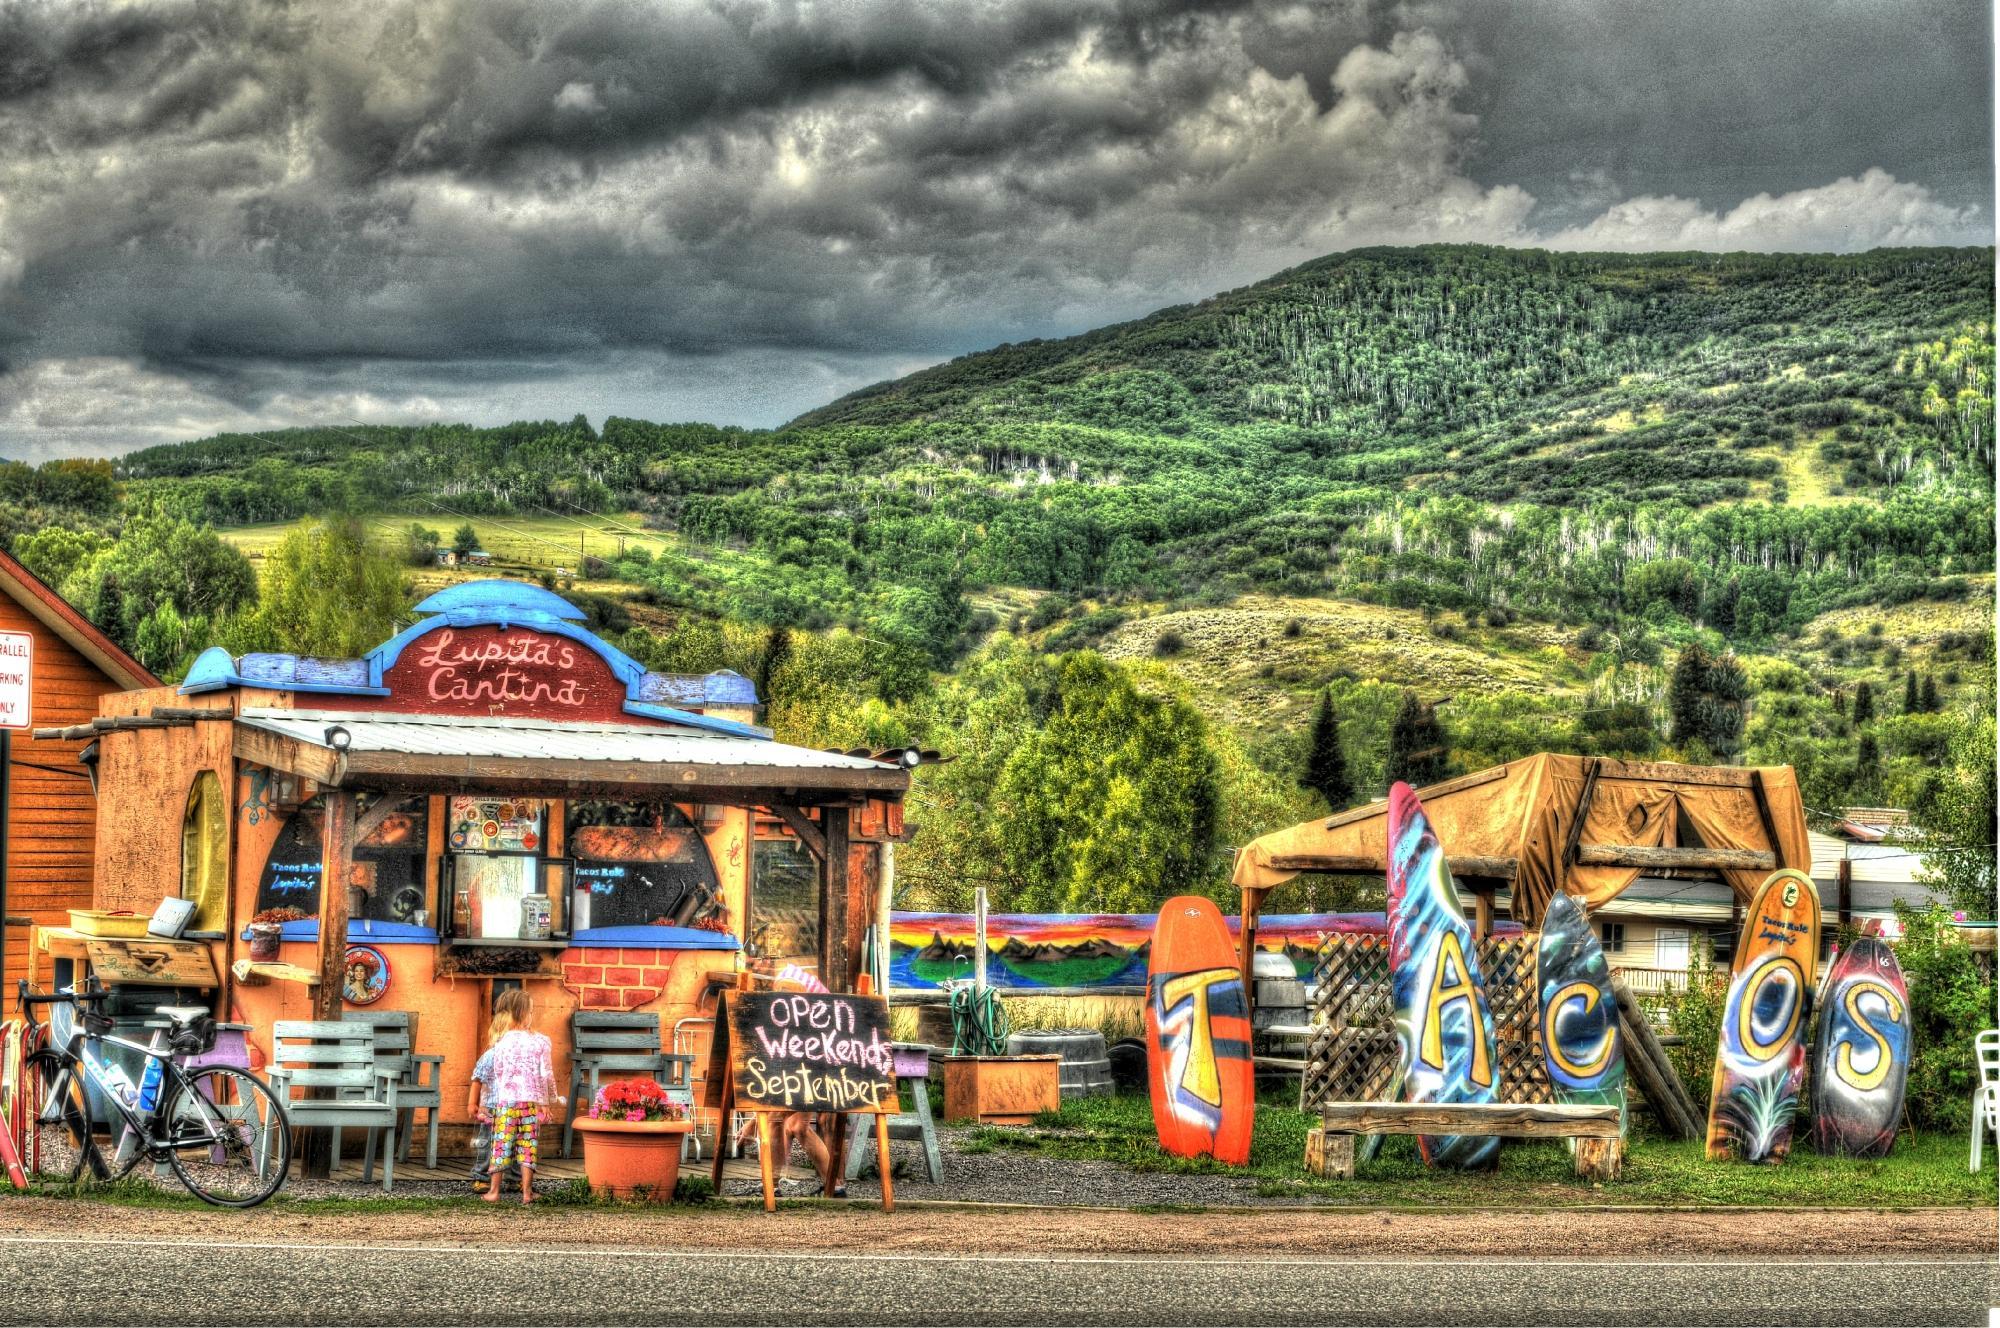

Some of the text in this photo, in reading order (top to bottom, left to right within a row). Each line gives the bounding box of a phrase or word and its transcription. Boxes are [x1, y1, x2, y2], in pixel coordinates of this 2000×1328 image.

[418, 630, 574, 672] Lupita's
[428, 667, 585, 705] Cantina
[270, 874, 315, 896] Lupita's
[271, 863, 323, 873] Tacos Rul
[747, 1056, 891, 1112] September
